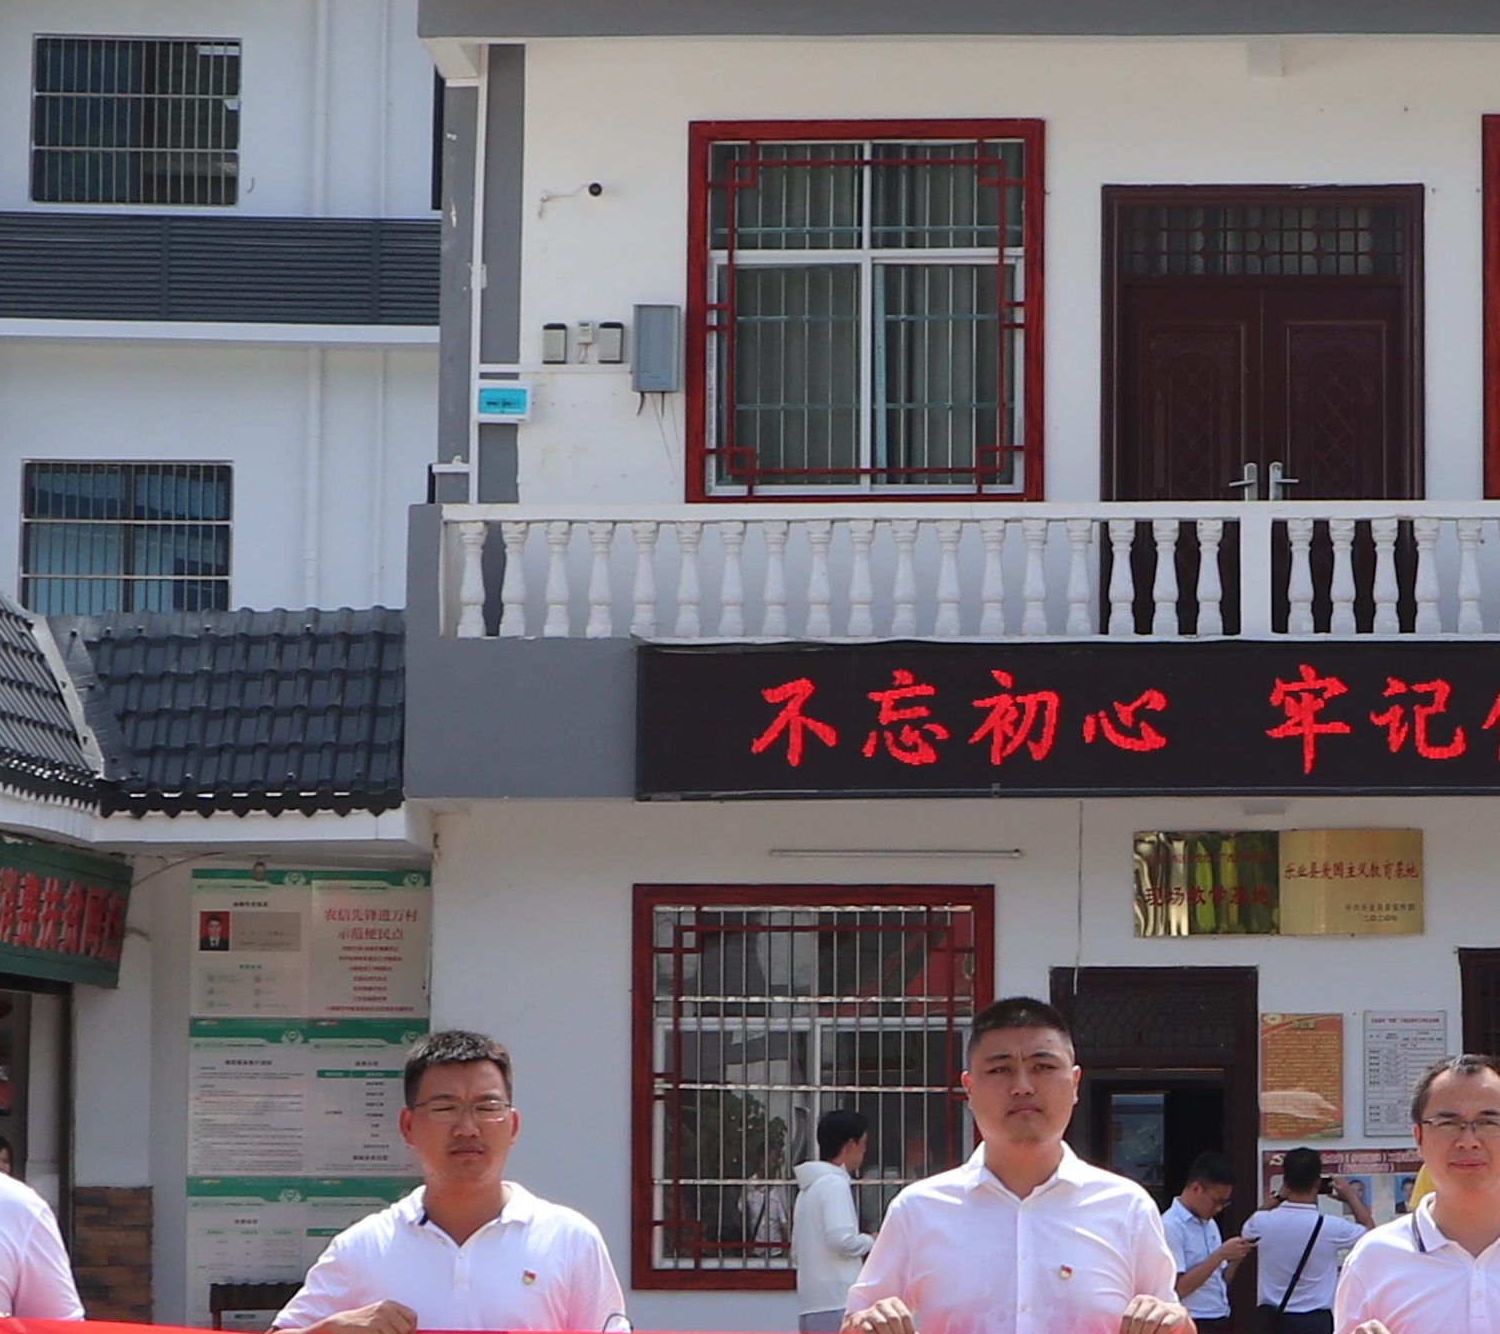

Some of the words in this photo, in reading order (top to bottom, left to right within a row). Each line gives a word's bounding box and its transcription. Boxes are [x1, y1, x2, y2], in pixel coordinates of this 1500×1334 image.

[751, 667, 1168, 768] 不忘初心
[1283, 860, 1419, 881] 乐业县爱国主义教育基地
[1143, 886, 1273, 907] 现场教学基地
[323, 908, 419, 923] 农信先锋进万村
[337, 926, 405, 941] 示范便民点
